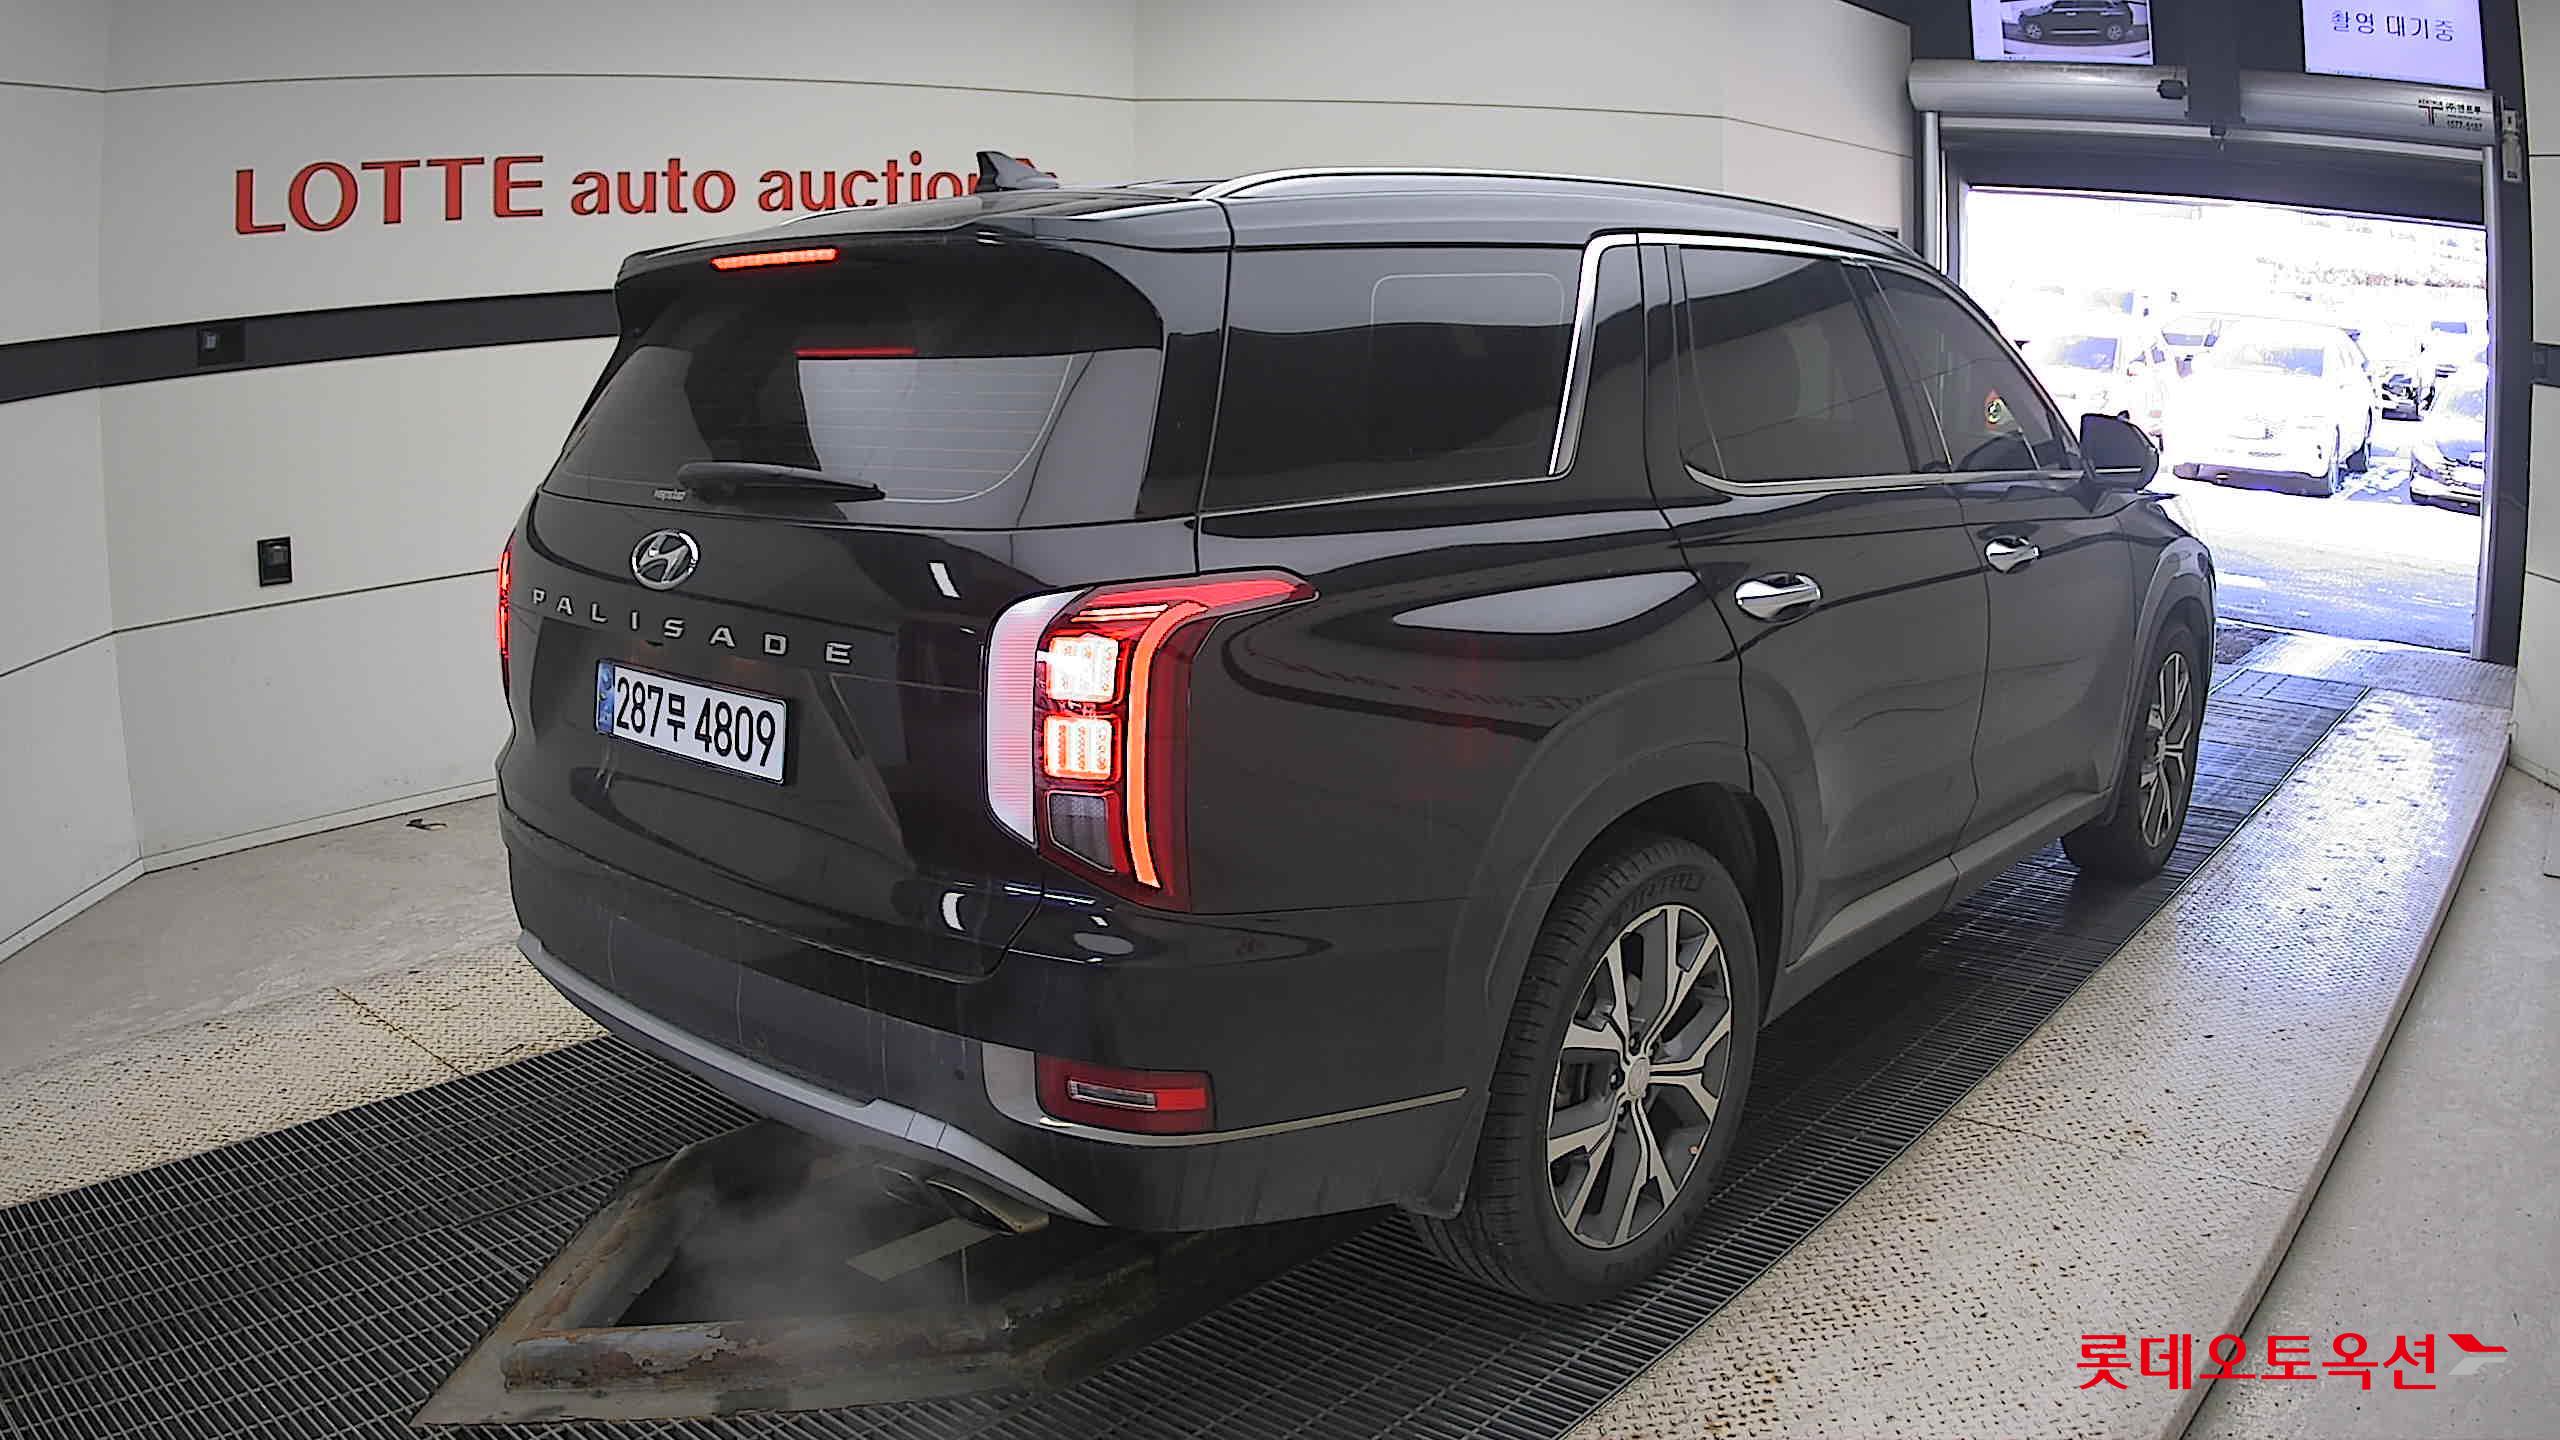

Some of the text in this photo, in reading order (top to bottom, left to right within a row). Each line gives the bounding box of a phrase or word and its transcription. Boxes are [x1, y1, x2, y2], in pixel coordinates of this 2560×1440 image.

[2386, 15, 2454, 42] 대기중
[235, 150, 979, 235] LOTTE auto auctio
[532, 587, 853, 666] PALISADE
[615, 676, 777, 767] 287무 4809
